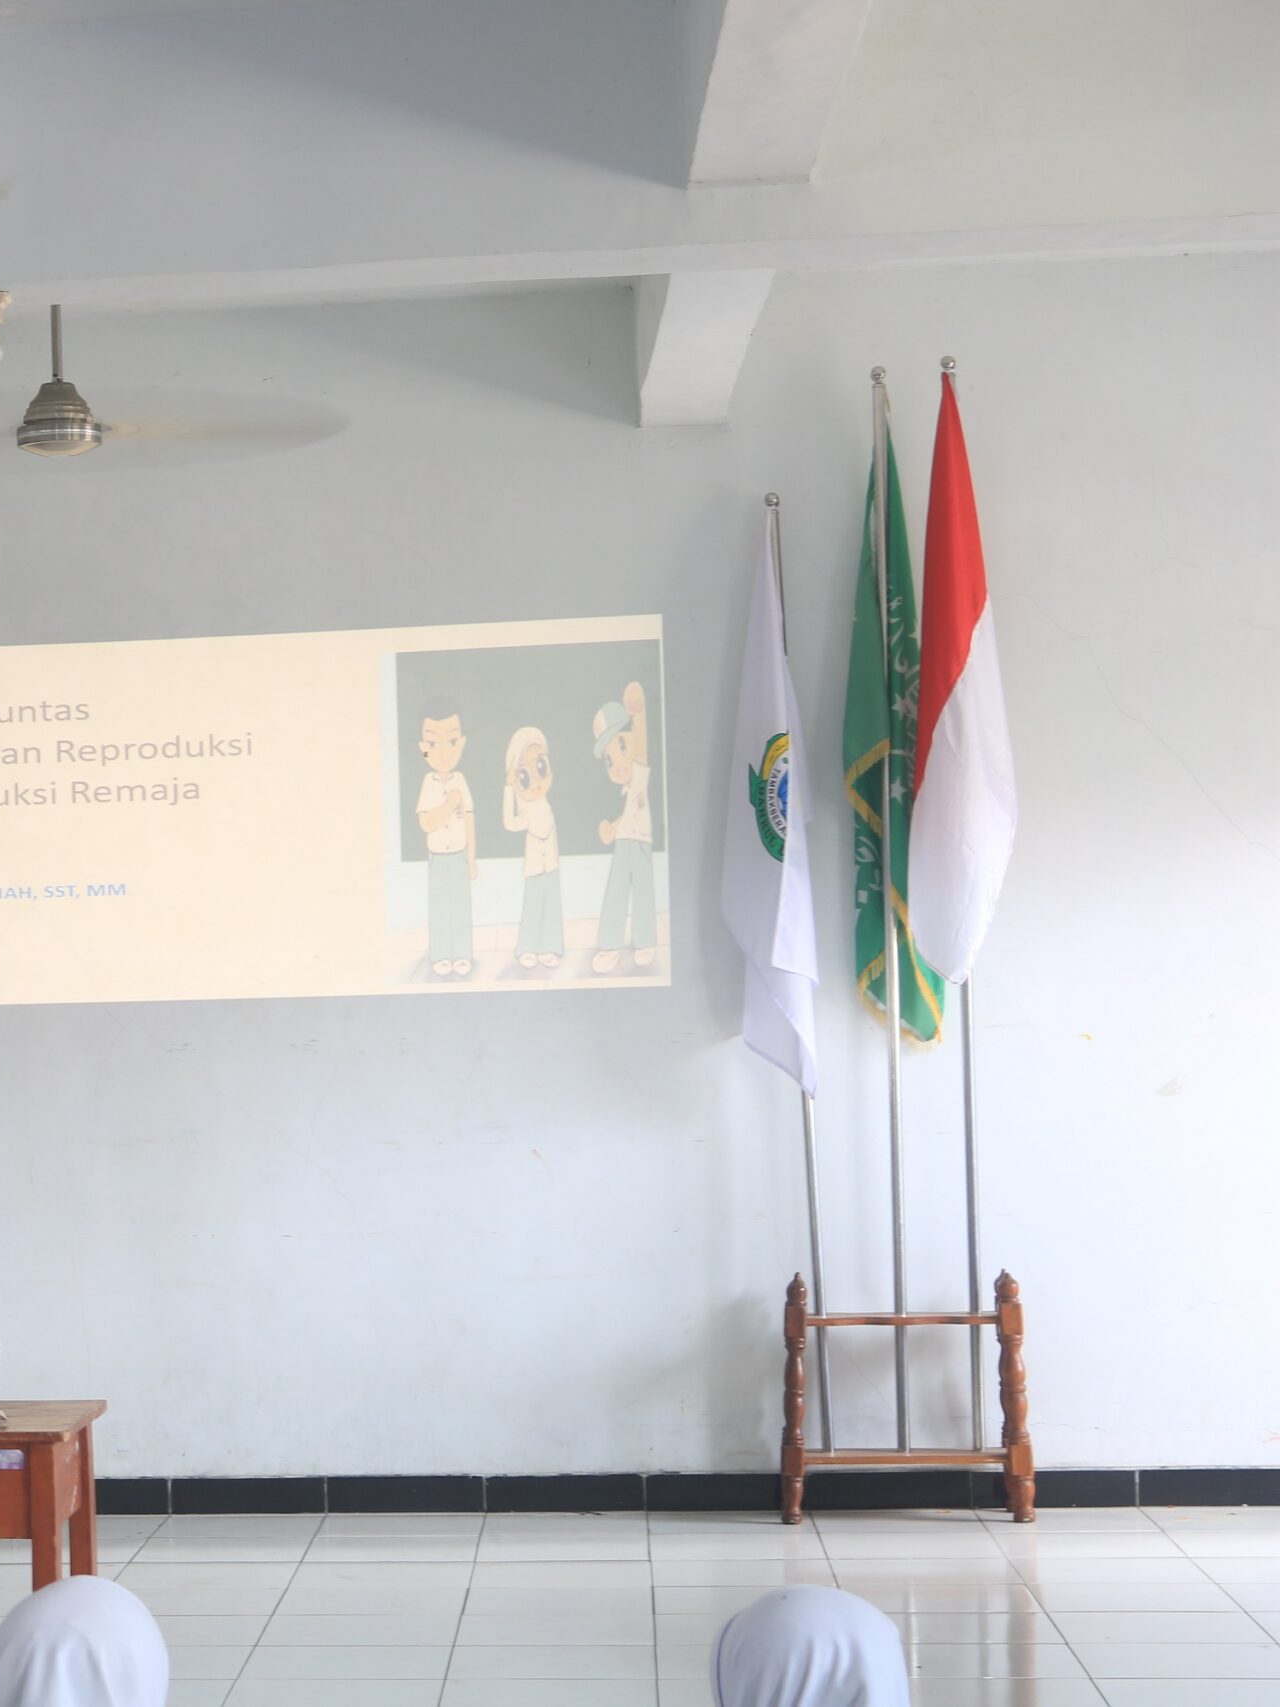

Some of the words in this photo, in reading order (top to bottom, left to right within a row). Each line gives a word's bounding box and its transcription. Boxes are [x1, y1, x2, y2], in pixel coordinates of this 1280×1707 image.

[56, 733, 253, 765] Reproduksi
[71, 778, 200, 806] Remaja
[768, 768, 787, 837] TAMBAKBERA
[44, 885, 80, 899] SST,
[87, 884, 126, 897] MM
